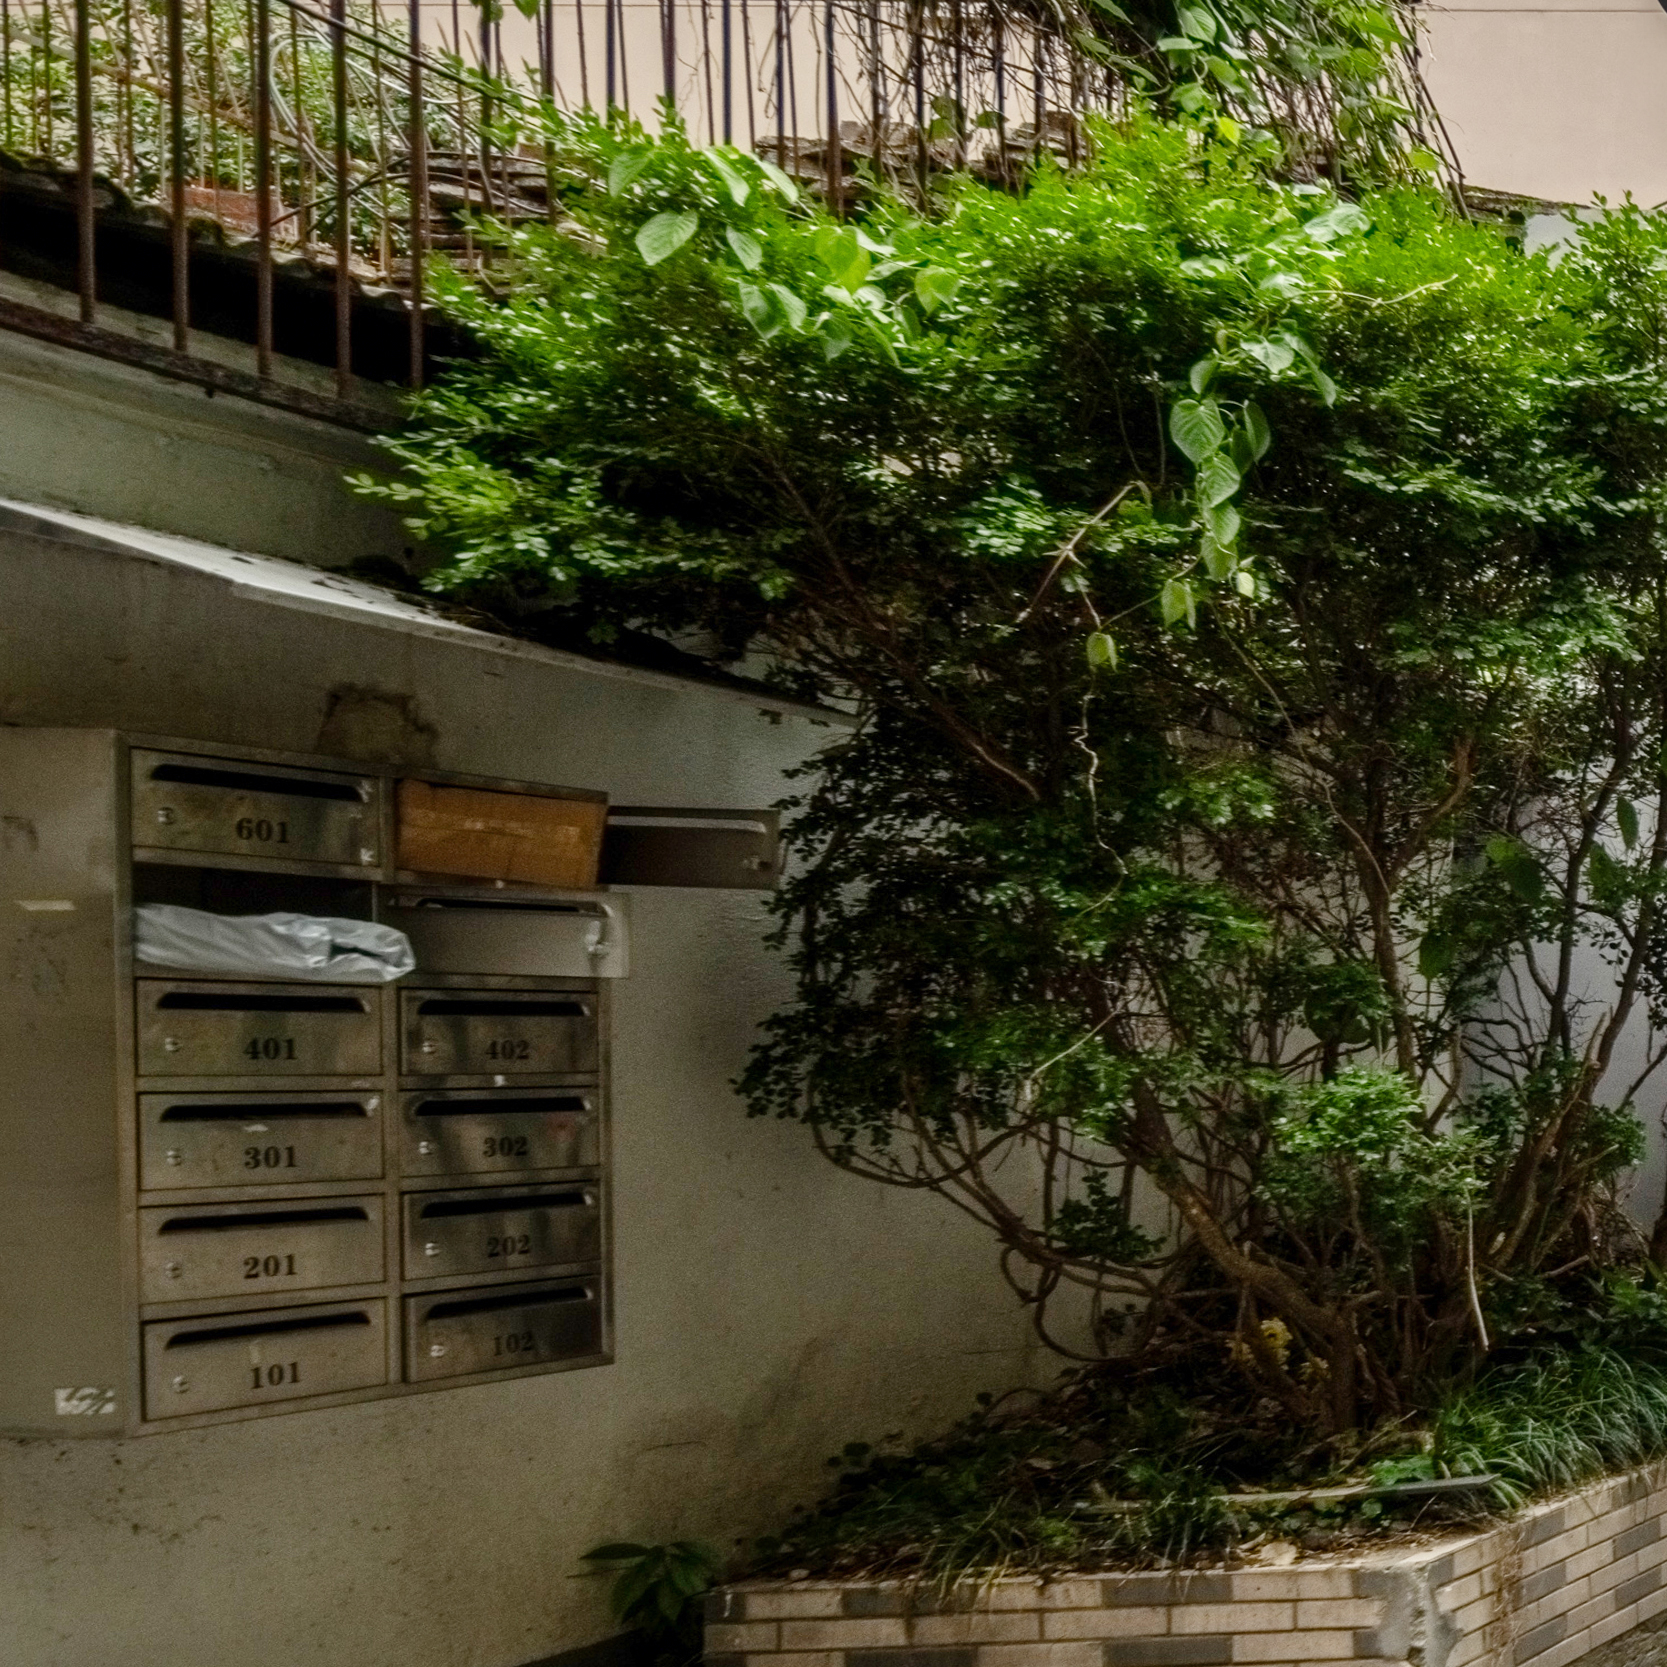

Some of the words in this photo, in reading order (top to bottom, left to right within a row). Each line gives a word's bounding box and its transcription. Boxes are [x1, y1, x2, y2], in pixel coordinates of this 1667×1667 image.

[235, 817, 291, 844] 601
[242, 1036, 298, 1061] 401
[485, 1040, 531, 1061] 402
[243, 1145, 298, 1170] 301
[482, 1135, 529, 1158] 302
[487, 1234, 530, 1259] 202
[243, 1254, 298, 1280] 201
[493, 1330, 533, 1356] 102
[249, 1362, 301, 1390] 101
